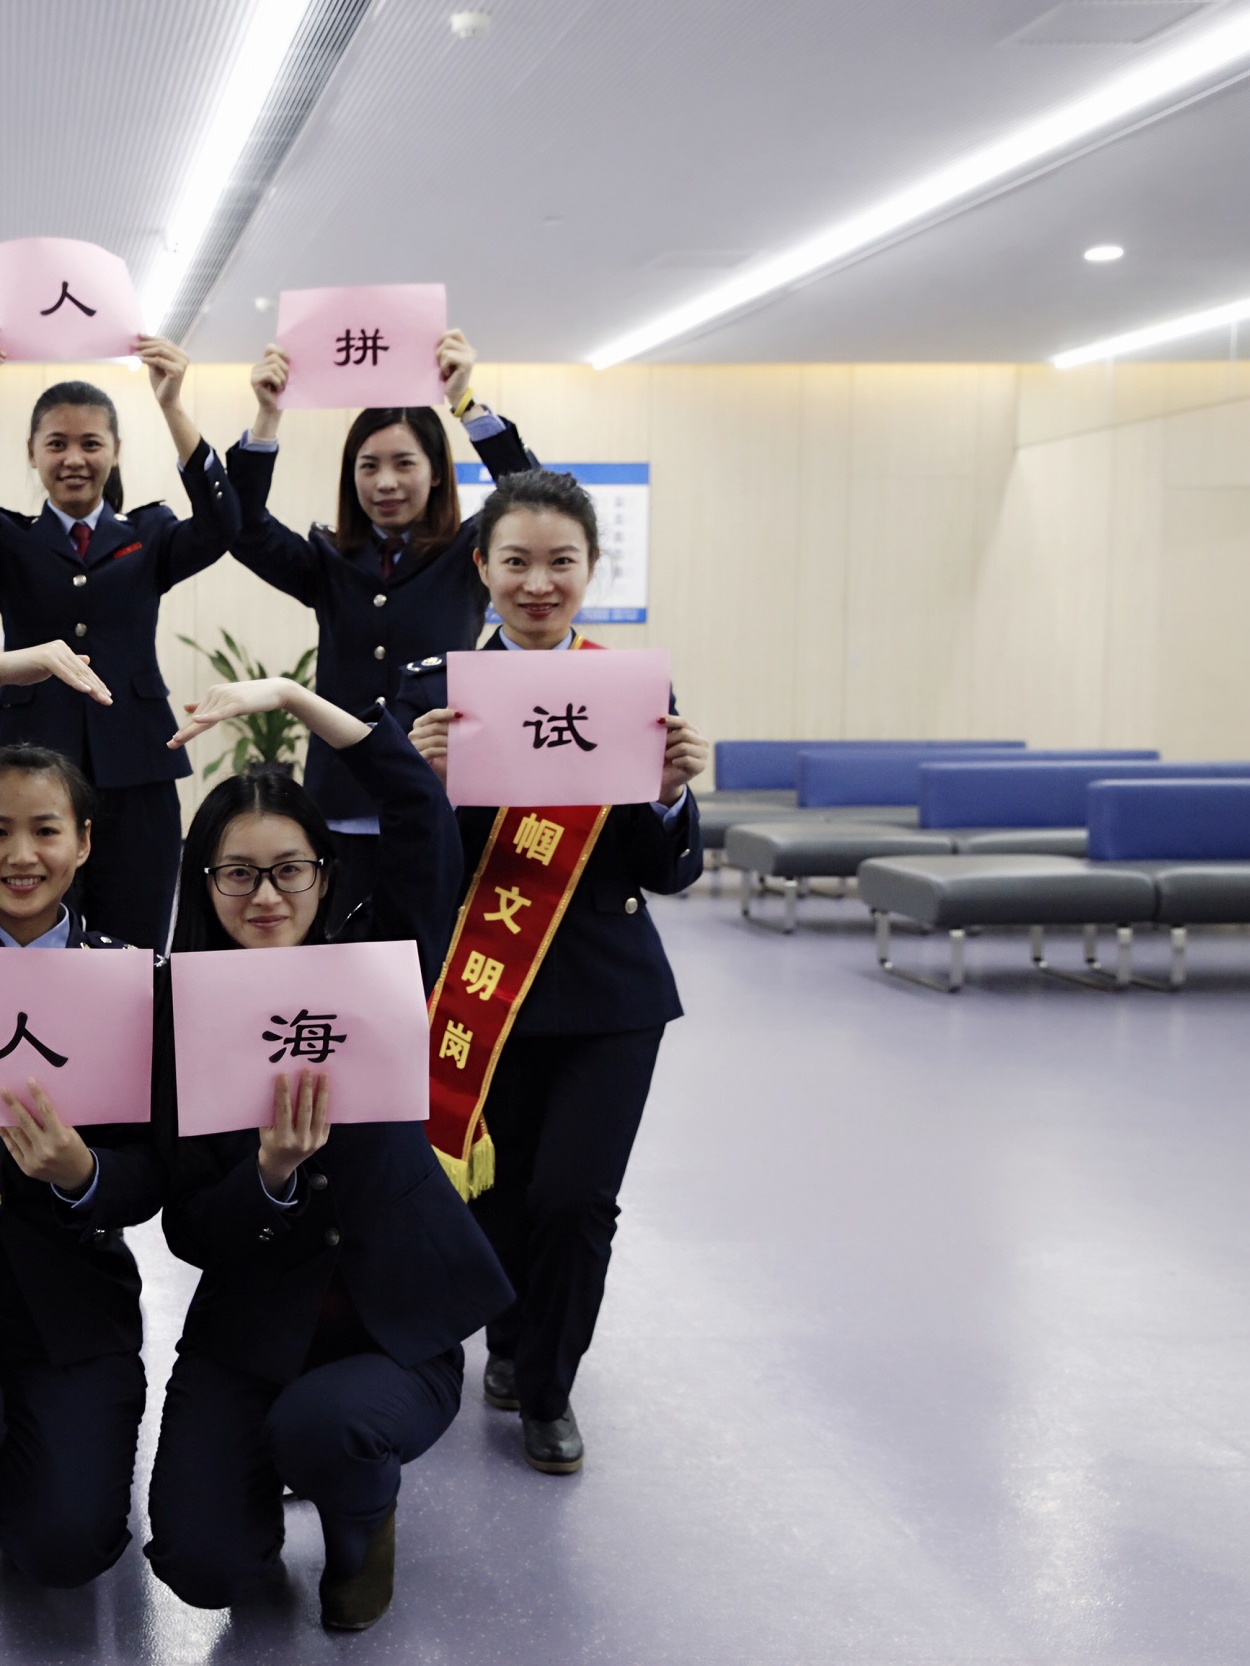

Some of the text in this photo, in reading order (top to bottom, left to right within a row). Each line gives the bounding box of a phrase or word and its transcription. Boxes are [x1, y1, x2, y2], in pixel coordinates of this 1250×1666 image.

[40, 281, 96, 317] 人
[336, 328, 390, 367] 拼
[522, 702, 598, 752] 试
[438, 812, 565, 1070] 帼文明岗
[261, 1008, 348, 1064] 海
